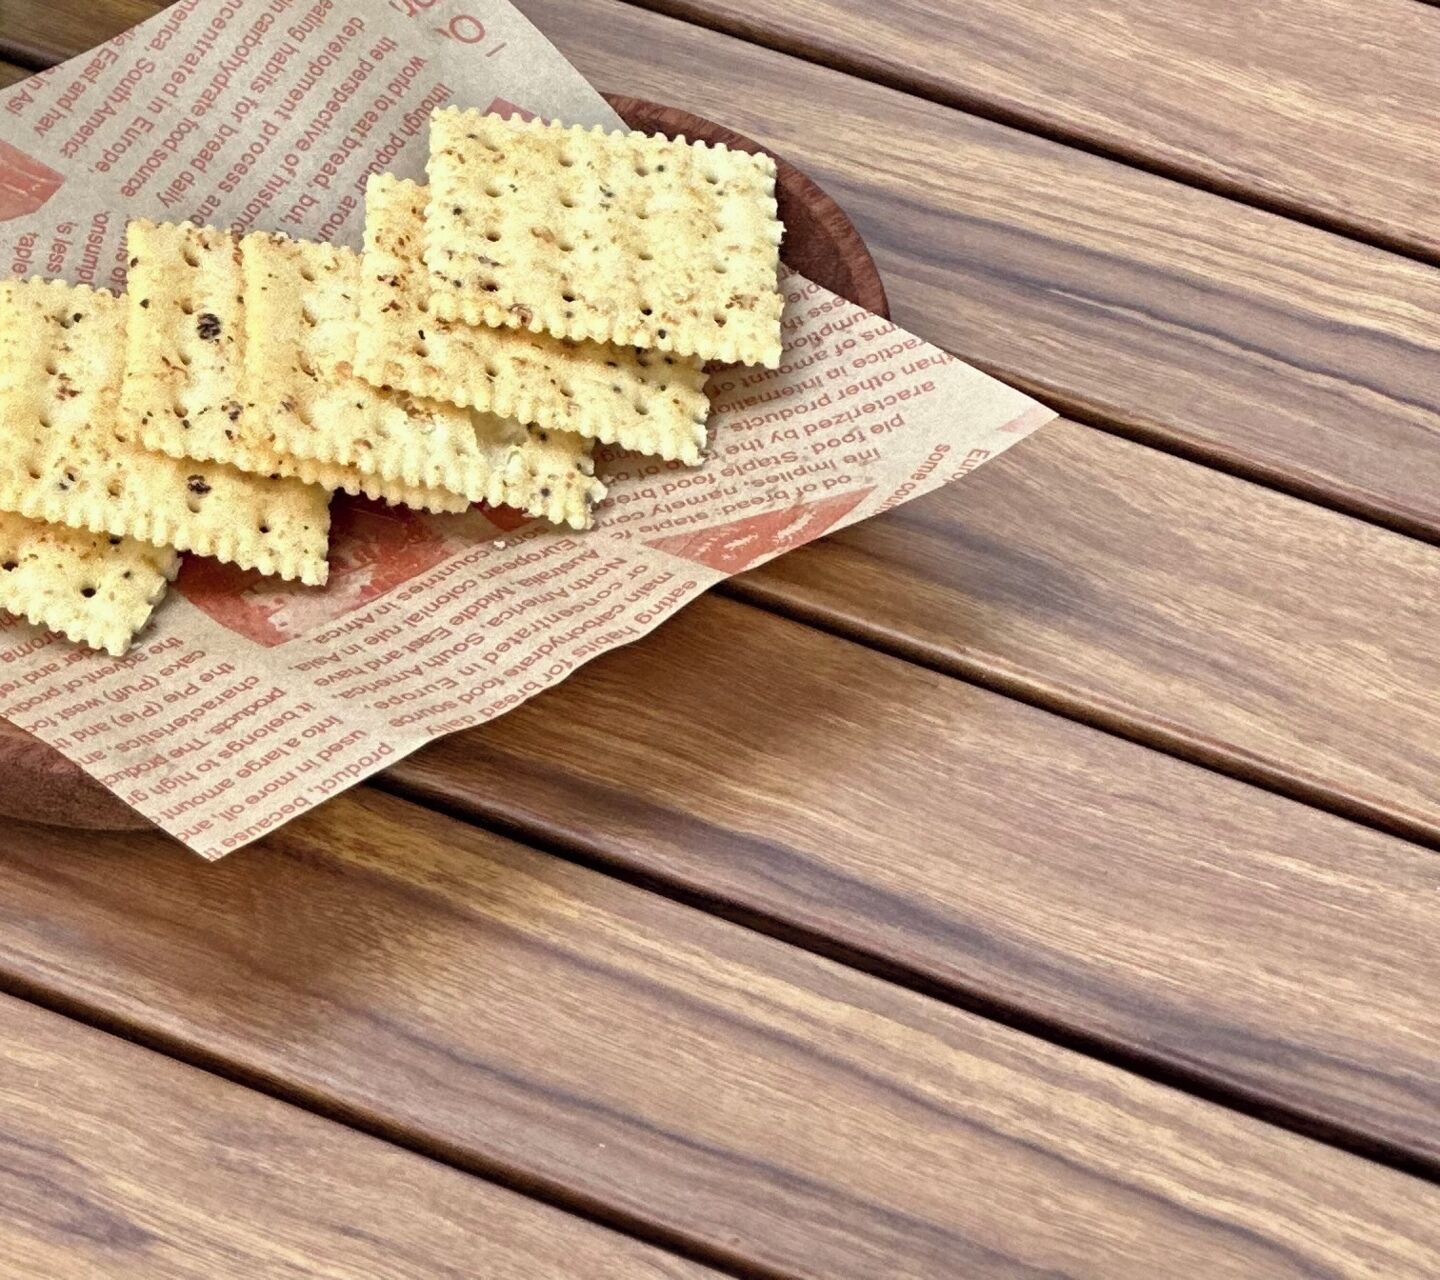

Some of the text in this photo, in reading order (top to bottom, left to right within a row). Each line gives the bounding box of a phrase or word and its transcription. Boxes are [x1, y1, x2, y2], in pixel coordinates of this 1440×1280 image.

[106, 57, 156, 104] South
[190, 12, 276, 117] carbohydrate
[249, 41, 301, 94] habits
[294, 36, 399, 152] the perspective
[161, 117, 201, 153] food
[217, 16, 366, 194] development process
[305, 55, 429, 190] world eat bread,
[87, 115, 156, 174] Europe,
[119, 148, 169, 198] source
[189, 123, 240, 174] bread
[155, 170, 196, 210] daily
[729, 392, 833, 433] products.
[719, 427, 867, 478] food. Staple
[638, 490, 790, 533] bread: staple
[649, 458, 838, 518] implies, namely
[305, 550, 491, 645] countries Africa.
[401, 532, 578, 629] European colonial
[448, 548, 601, 626] Australia, Middle
[330, 586, 570, 700] America, America,
[363, 581, 624, 710] concentrated Europe,
[571, 580, 697, 656] eating habits
[102, 674, 161, 703] (Puff)
[388, 603, 627, 728] carbohydrate source
[106, 675, 261, 753] characteristics,
[109, 700, 164, 728] (Pie)
[203, 686, 288, 744] products.
[217, 710, 302, 760] belongs
[160, 714, 345, 820] into large amount
[210, 729, 369, 823] used more oil,
[221, 741, 395, 847] product, because
